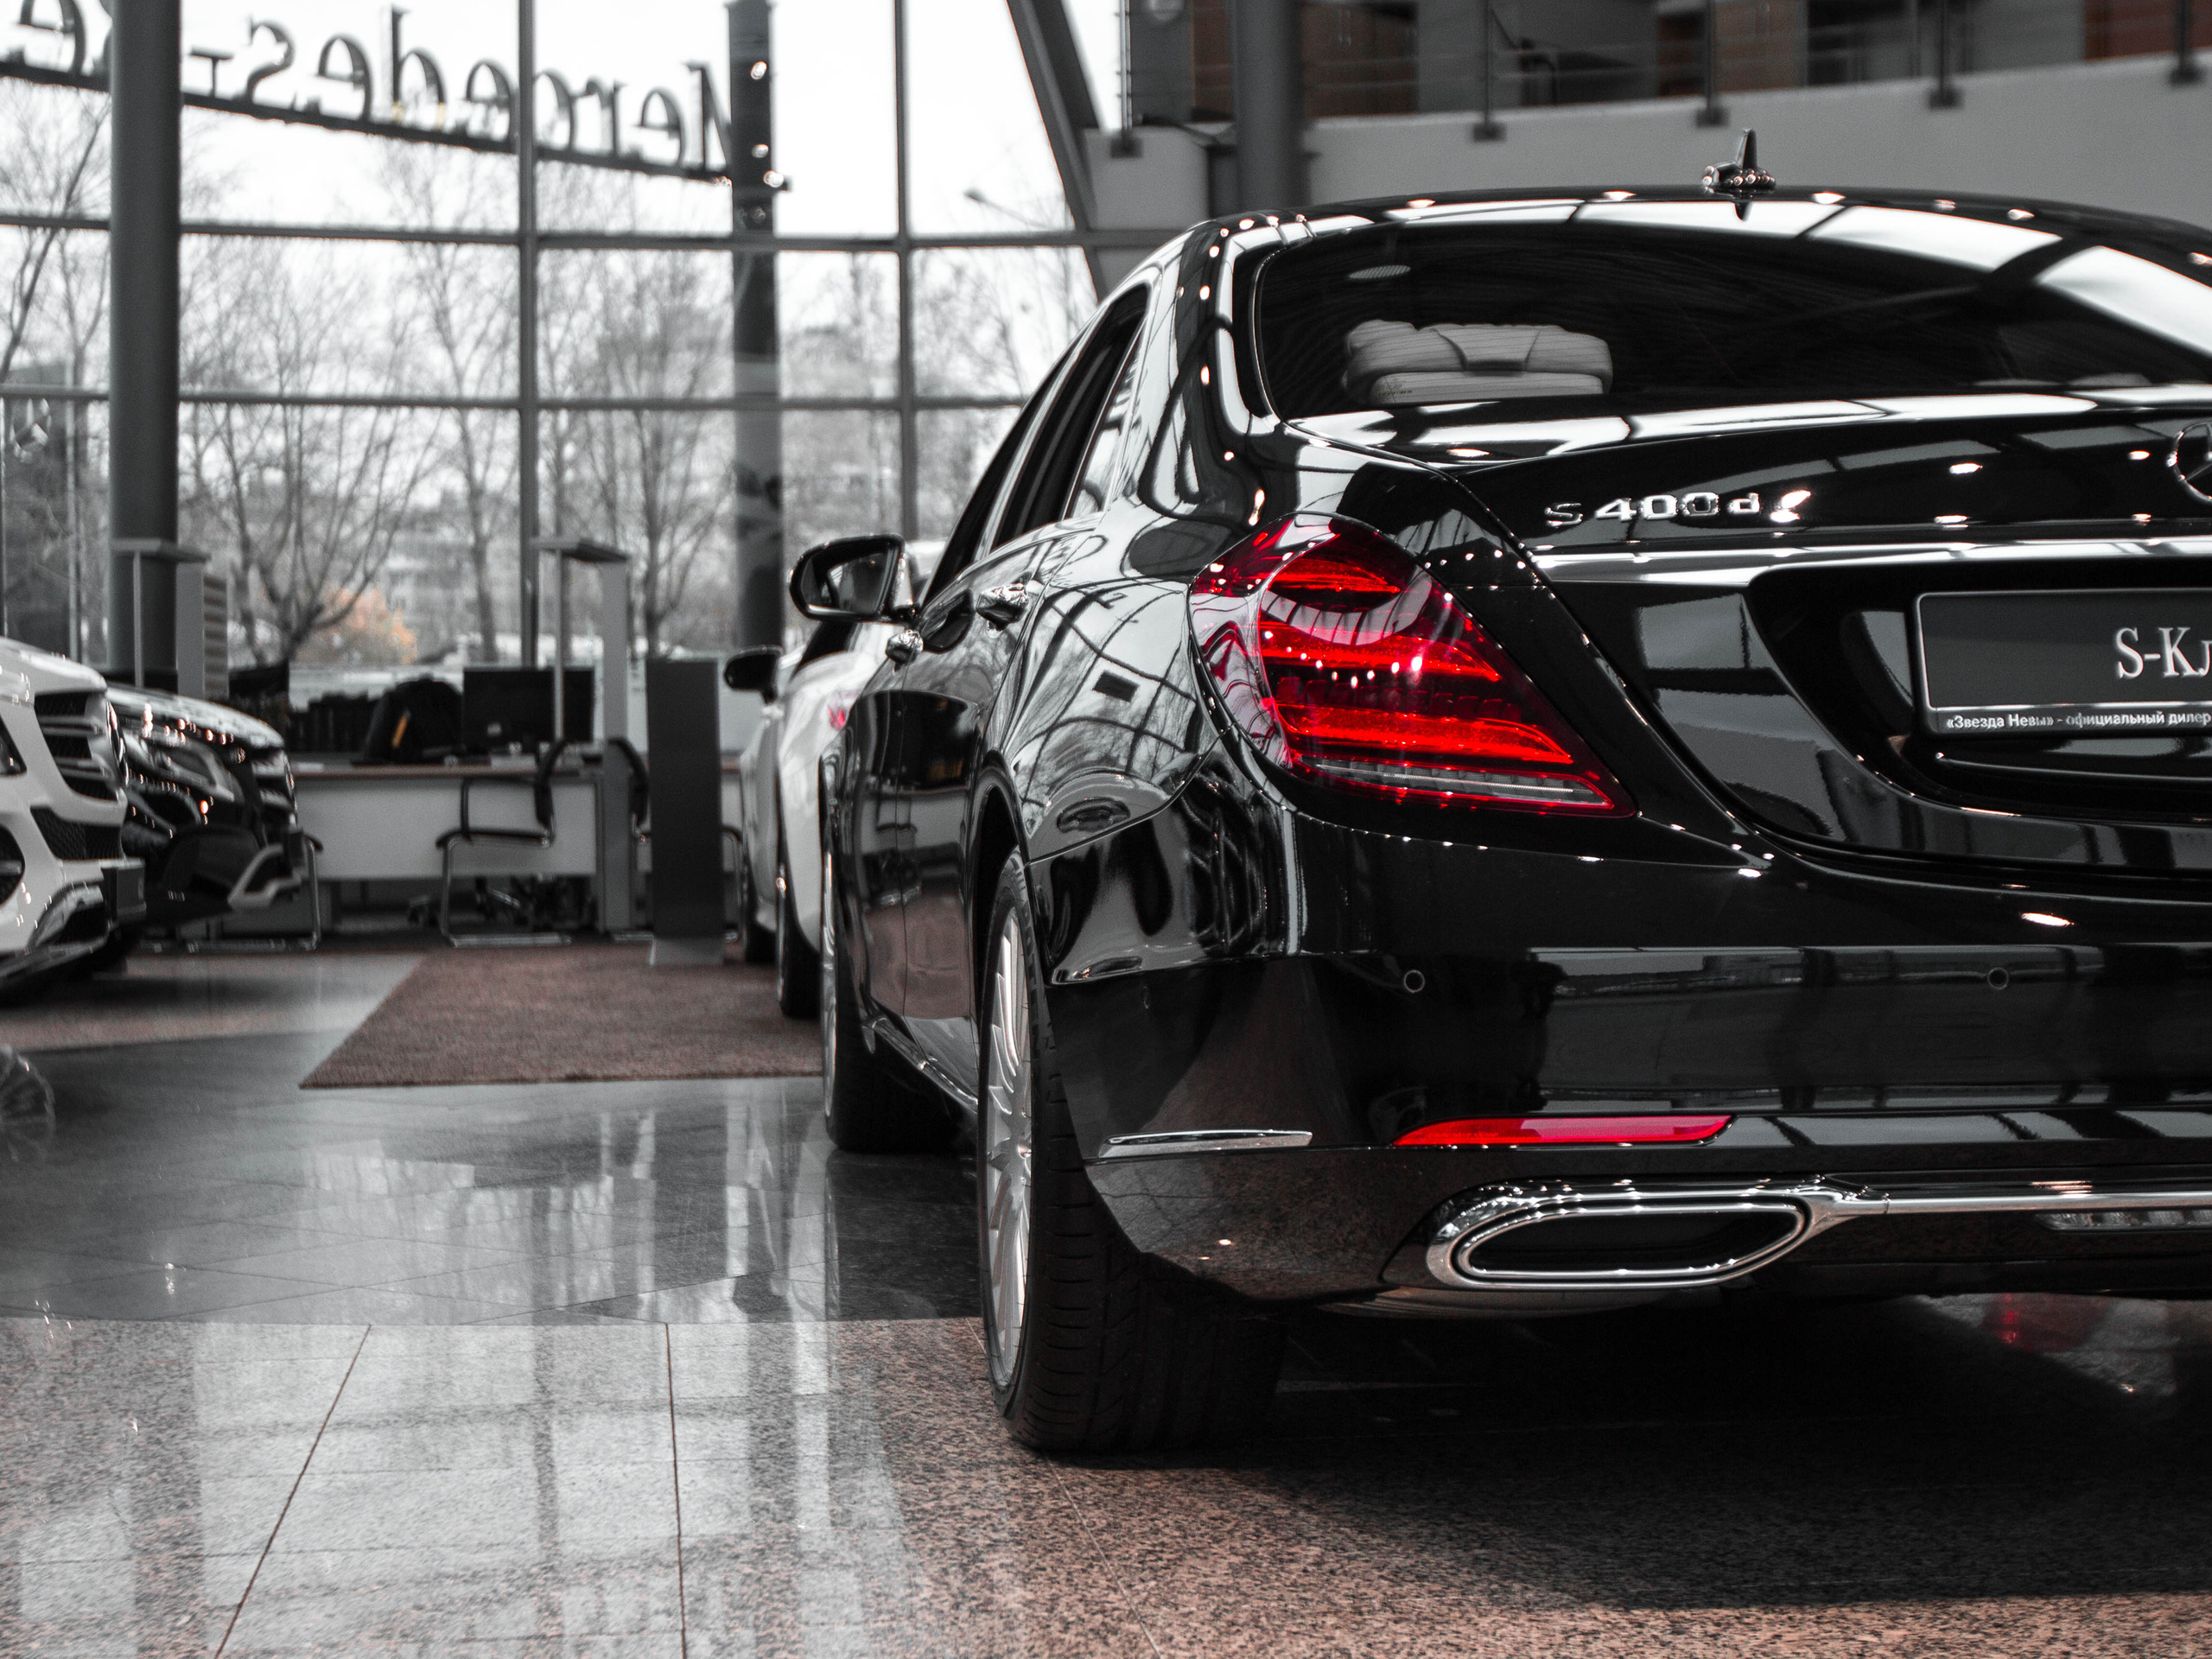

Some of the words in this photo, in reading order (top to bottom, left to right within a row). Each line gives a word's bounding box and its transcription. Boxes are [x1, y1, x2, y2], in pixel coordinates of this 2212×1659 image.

[1947, 715, 2005, 729] «Звезда
[2007, 713, 2055, 728] Невы»
[2065, 710, 2165, 728] официальный
[2169, 712, 2212, 727] дилер
